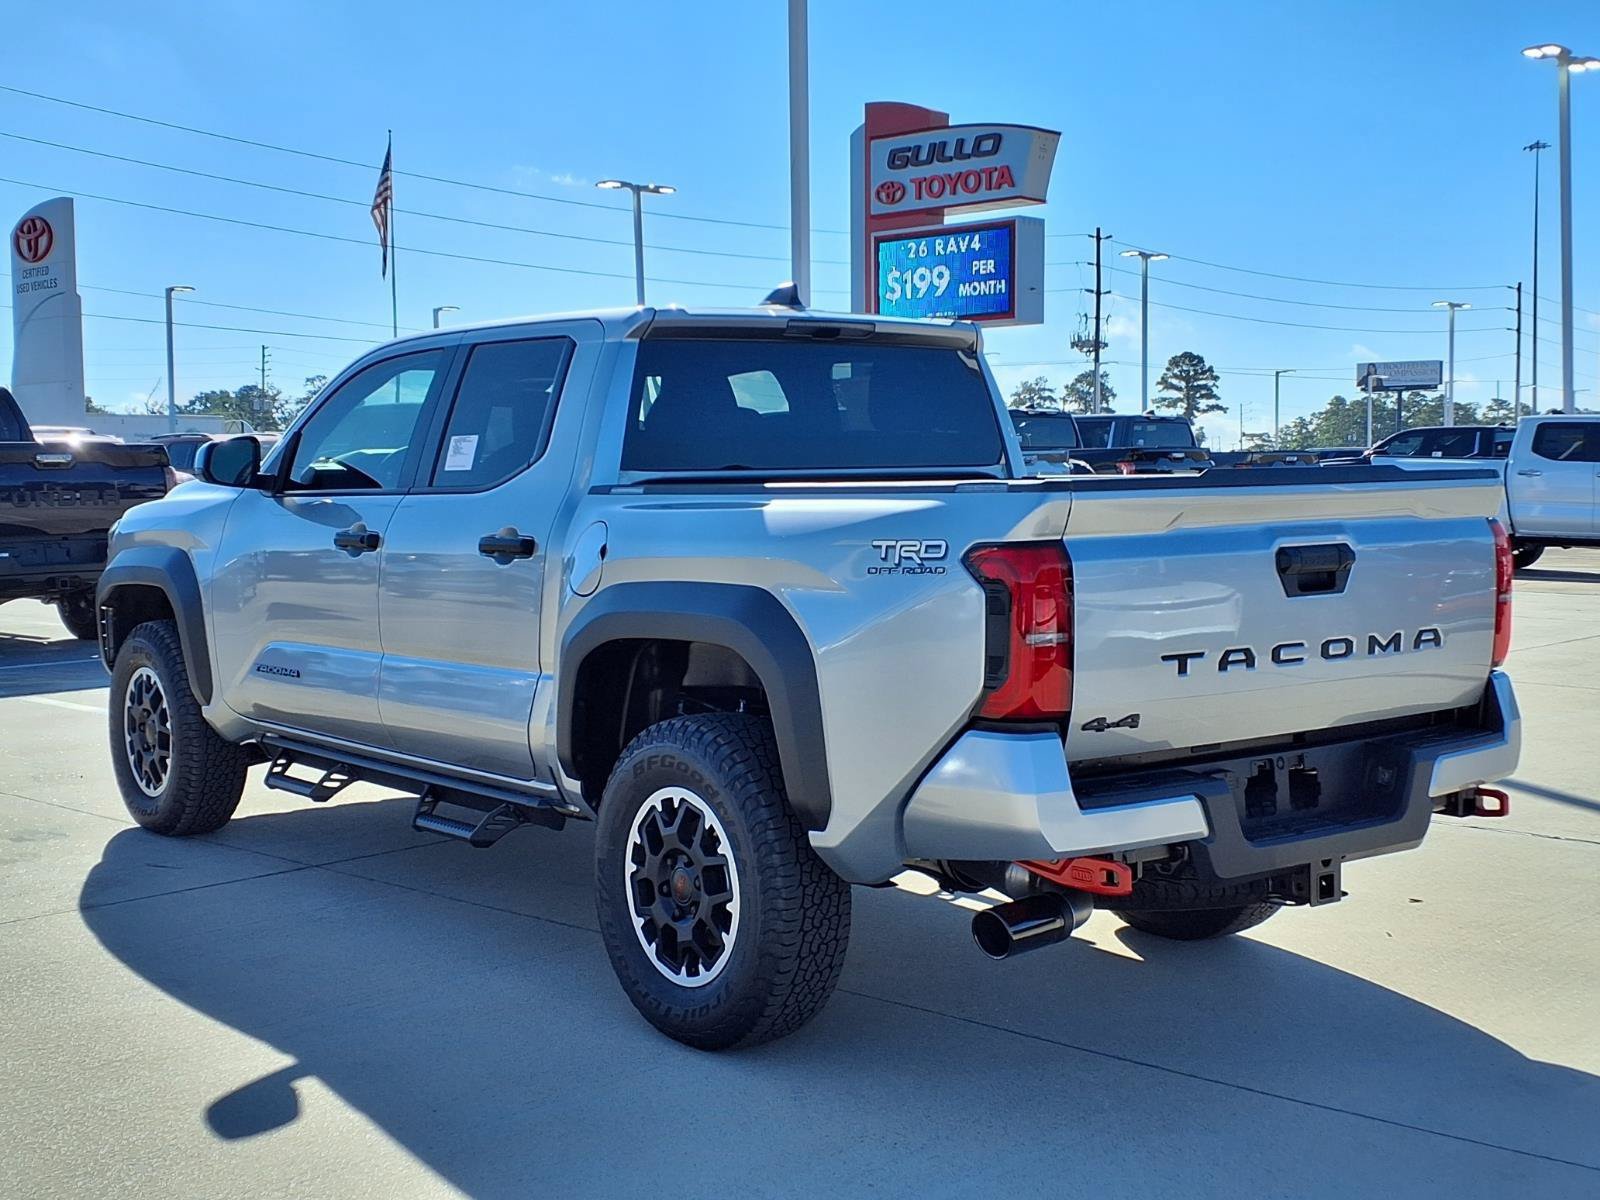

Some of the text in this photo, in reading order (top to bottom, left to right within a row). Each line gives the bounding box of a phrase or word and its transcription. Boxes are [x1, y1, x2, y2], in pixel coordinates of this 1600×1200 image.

[887, 133, 1002, 170] GULLO
[910, 165, 1015, 200] TOYOTA
[935, 234, 981, 256] RAV4
[22, 266, 49, 279] CERTIFIED
[972, 259, 996, 275] PER
[16, 278, 58, 294] USED VEHICLES
[885, 265, 951, 306] $199
[958, 279, 1006, 297] MONTH
[872, 539, 948, 566] TRD
[867, 567, 946, 575] OFF ROAD
[1160, 628, 1443, 677] TACOMA
